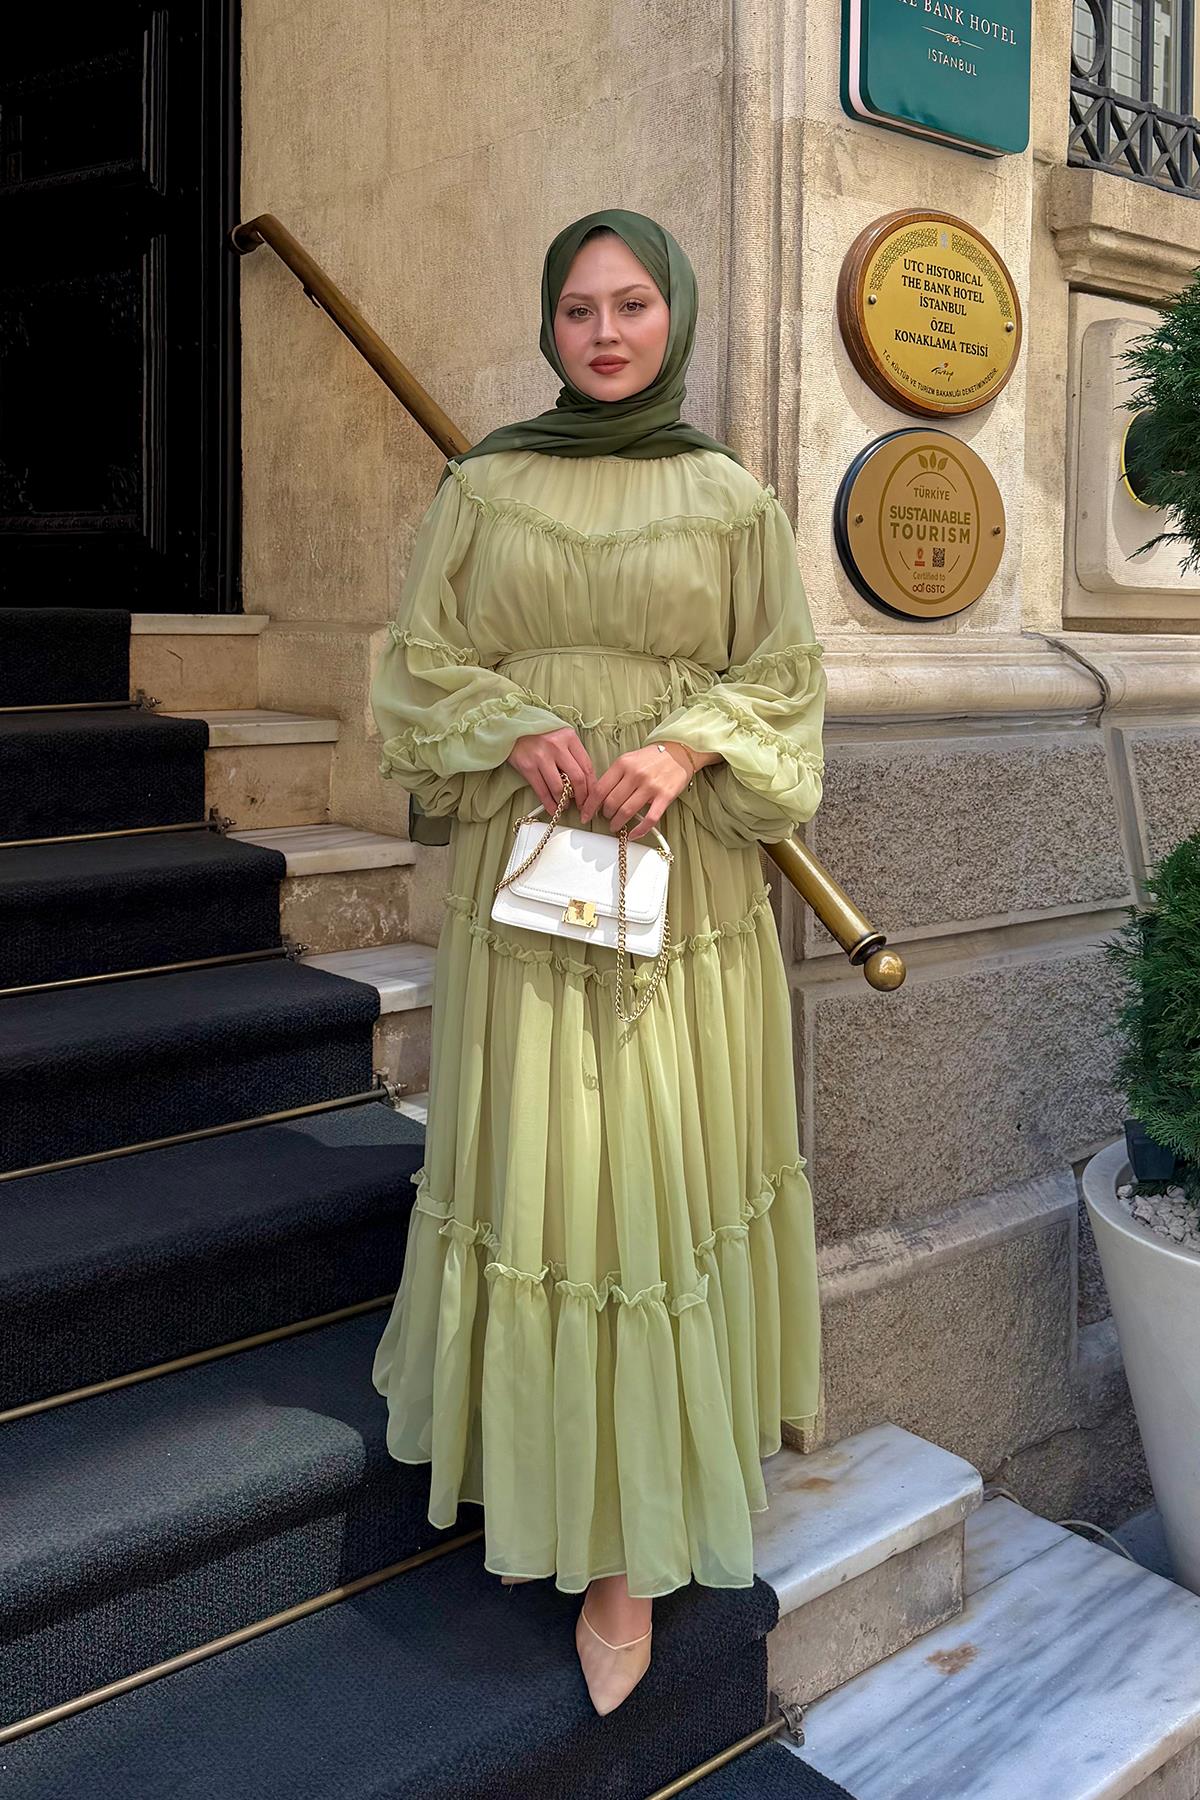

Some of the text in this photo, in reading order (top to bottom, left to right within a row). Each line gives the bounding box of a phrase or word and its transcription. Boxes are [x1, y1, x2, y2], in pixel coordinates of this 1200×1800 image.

[923, 0, 1017, 46] BANK HOTEL
[903, 258, 984, 287] UTC HISTORICAL
[902, 275, 985, 304] THE BANK HOTEL
[920, 293, 968, 316] İSTANBUL
[930, 317, 956, 335] ÖZEL
[894, 329, 989, 358] KONAKLAMA TESİSİ
[910, 378, 917, 388] VE
[913, 485, 951, 501] TÜRKİYE
[890, 505, 972, 526] SUSTAINABLE
[890, 522, 971, 545] TOURISM
[926, 584, 946, 594] GSTC
